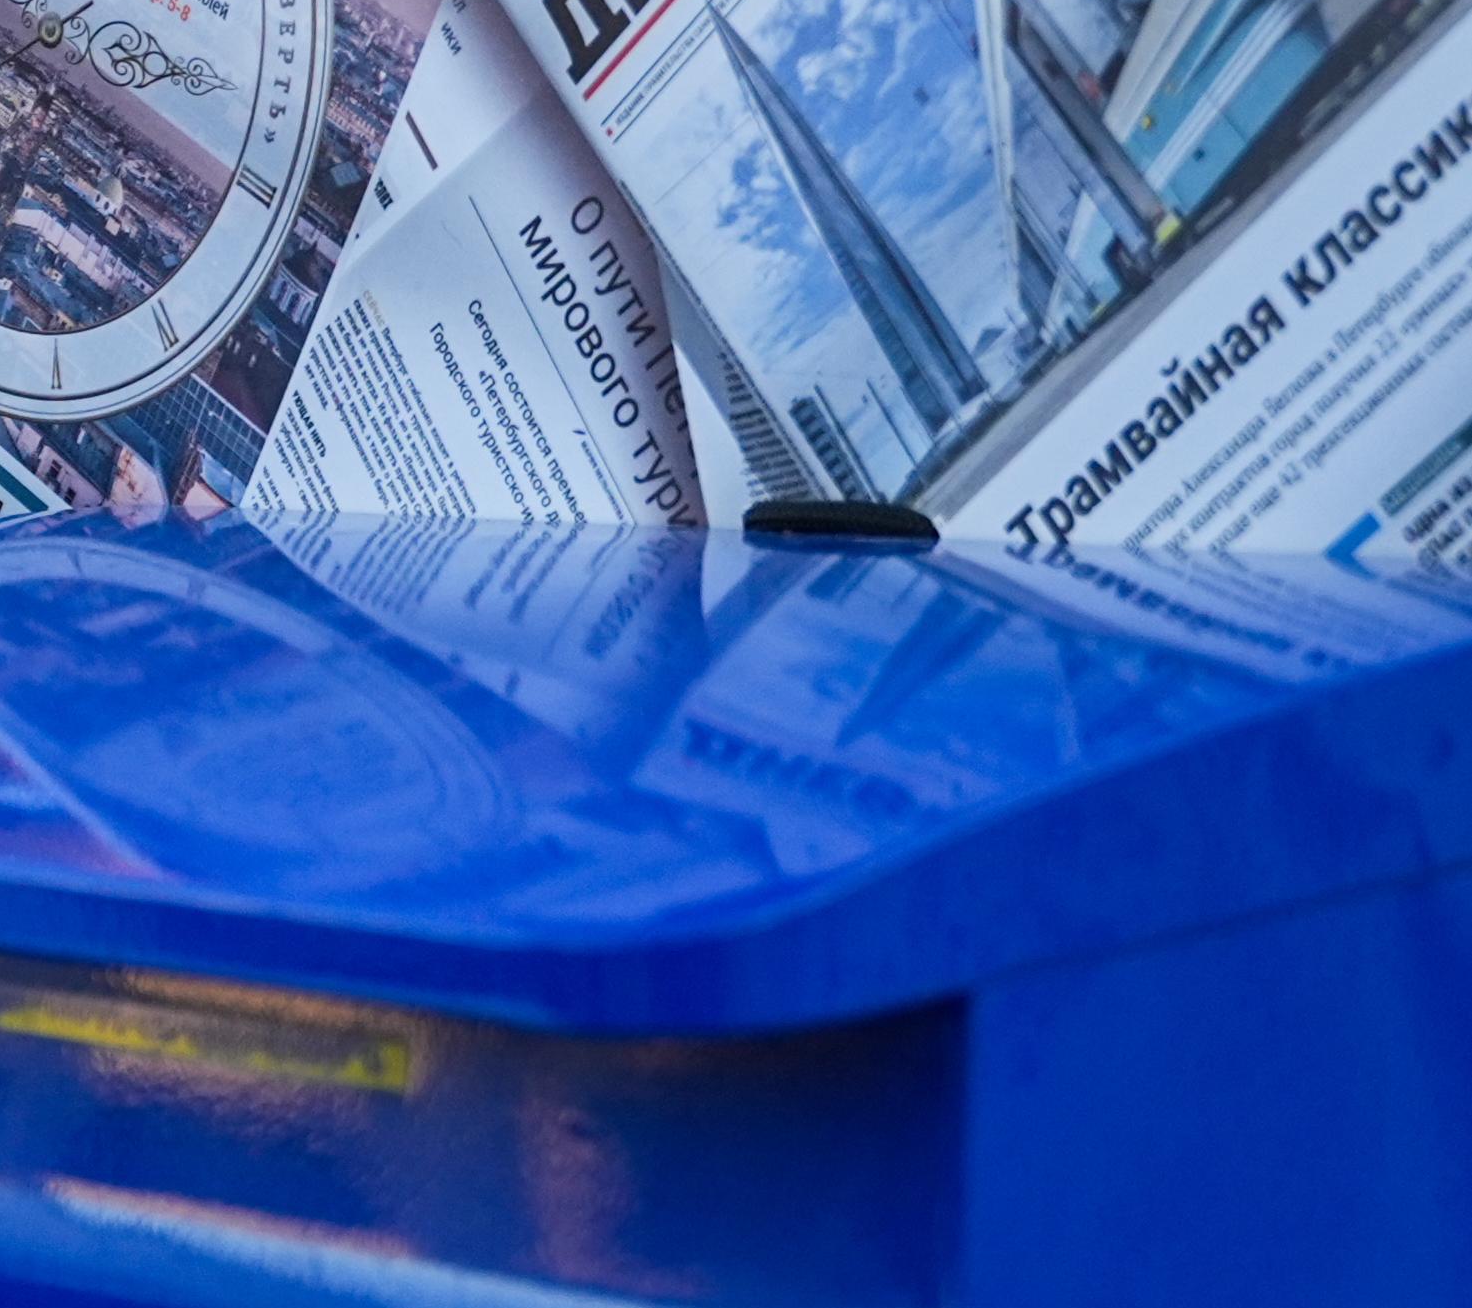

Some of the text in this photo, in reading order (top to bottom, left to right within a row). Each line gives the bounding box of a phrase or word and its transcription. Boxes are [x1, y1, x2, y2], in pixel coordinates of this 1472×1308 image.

[324, 324, 343, 356] можно
[333, 315, 346, 333] так
[342, 331, 359, 357] было
[507, 213, 644, 435] мирового
[571, 196, 656, 347] О пути
[364, 350, 383, 382] только
[379, 381, 403, 419] России,
[367, 330, 413, 413] привлекательных
[408, 414, 448, 483] туристических
[379, 327, 410, 377] Петербург
[423, 321, 487, 420] Городского
[462, 298, 512, 372] Сегодня
[499, 369, 556, 458] состоится
[1004, 294, 1285, 547] Трамвайная
[470, 367, 558, 510] «Петербургского
